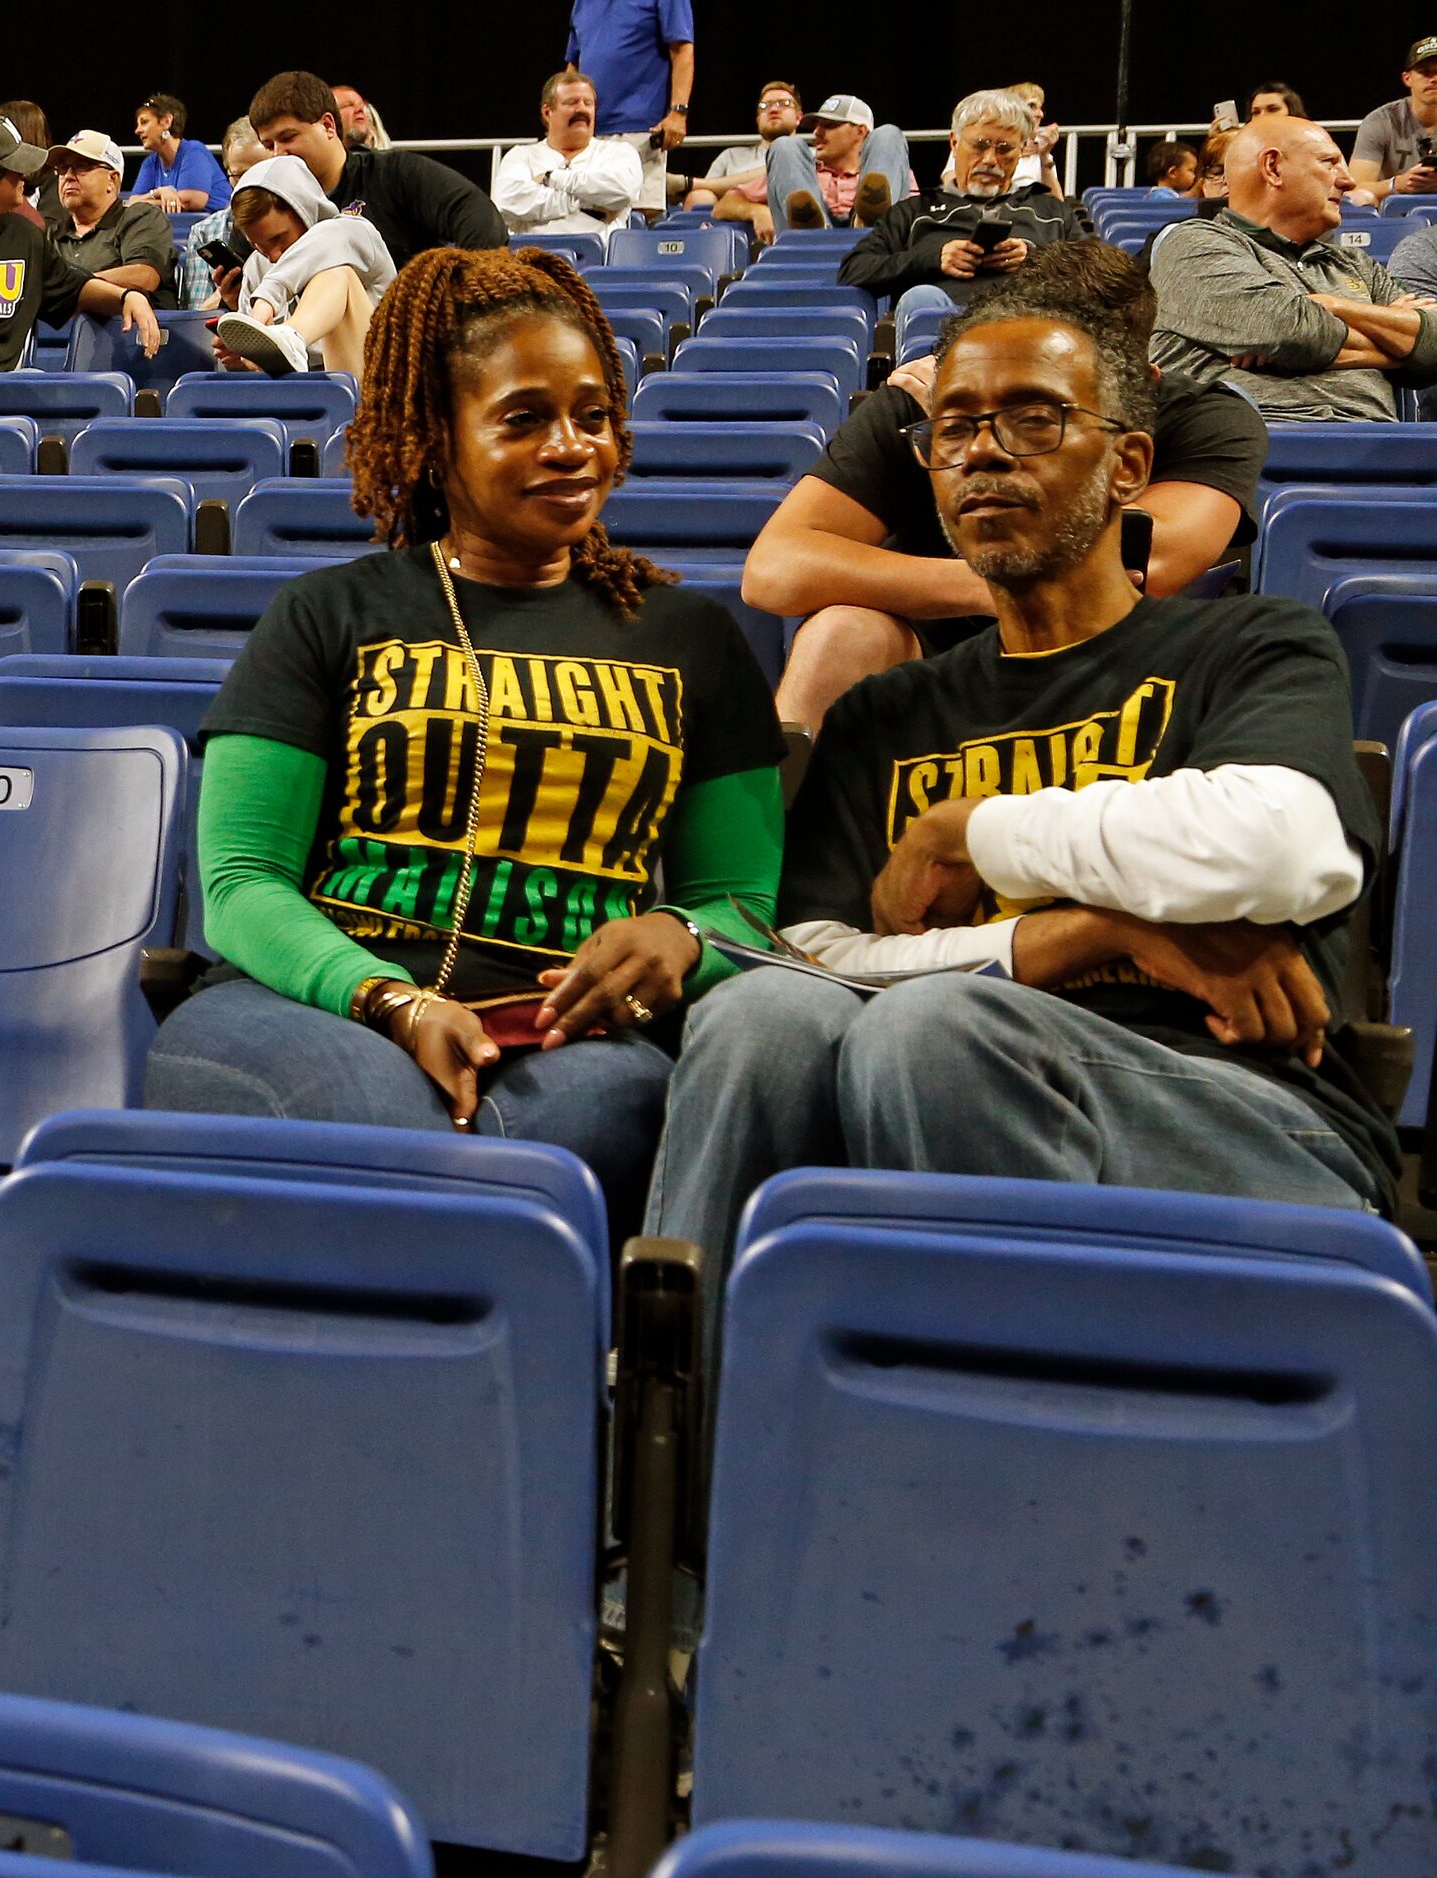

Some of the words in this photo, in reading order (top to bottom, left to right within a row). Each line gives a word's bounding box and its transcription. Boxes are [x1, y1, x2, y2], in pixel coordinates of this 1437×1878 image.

[666, 243, 678, 253] 10
[1348, 234, 1363, 245] 14
[366, 643, 673, 746] STRAIGHT
[351, 716, 671, 875] OUTTA
